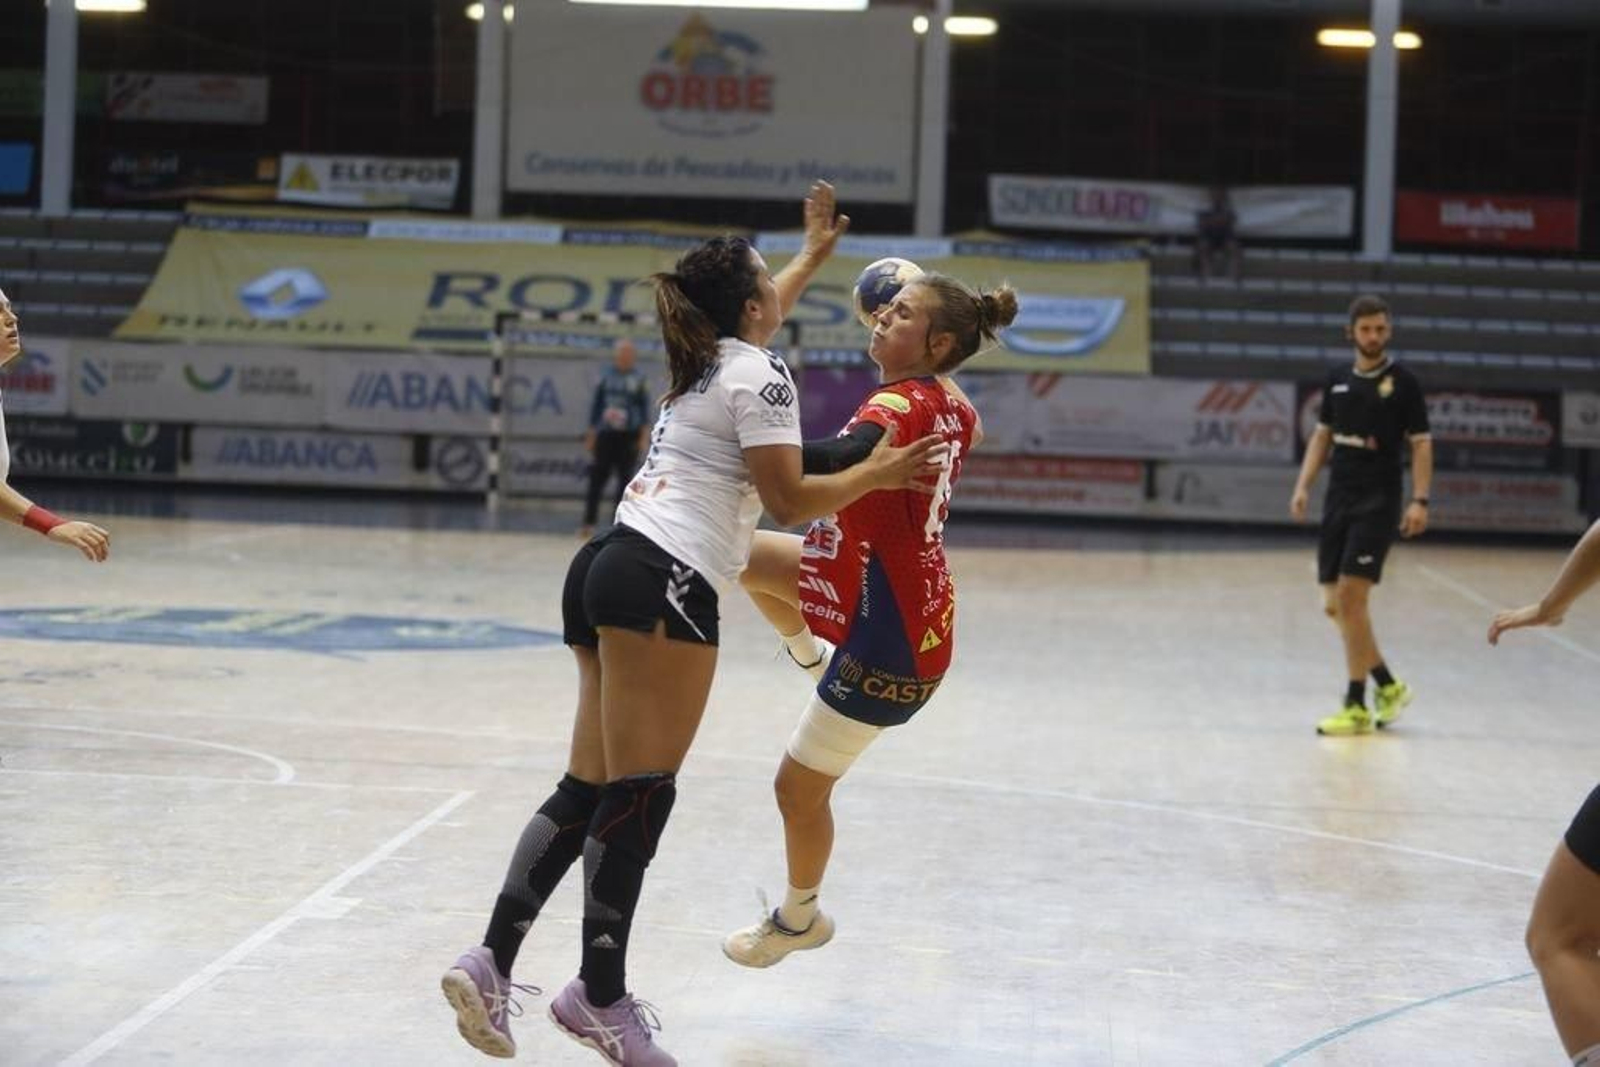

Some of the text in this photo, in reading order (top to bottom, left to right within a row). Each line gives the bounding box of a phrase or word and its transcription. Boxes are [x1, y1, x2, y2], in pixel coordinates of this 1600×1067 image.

[640, 74, 776, 114] ORBE
[330, 162, 454, 184] ELECPOR
[642, 156, 669, 180] de
[674, 156, 774, 183] Pescados
[777, 163, 790, 185] y
[798, 160, 897, 184] Mariscos
[157, 312, 381, 333] RENAULT
[368, 370, 563, 416] ABANCA
[233, 434, 378, 474] ABANCA
